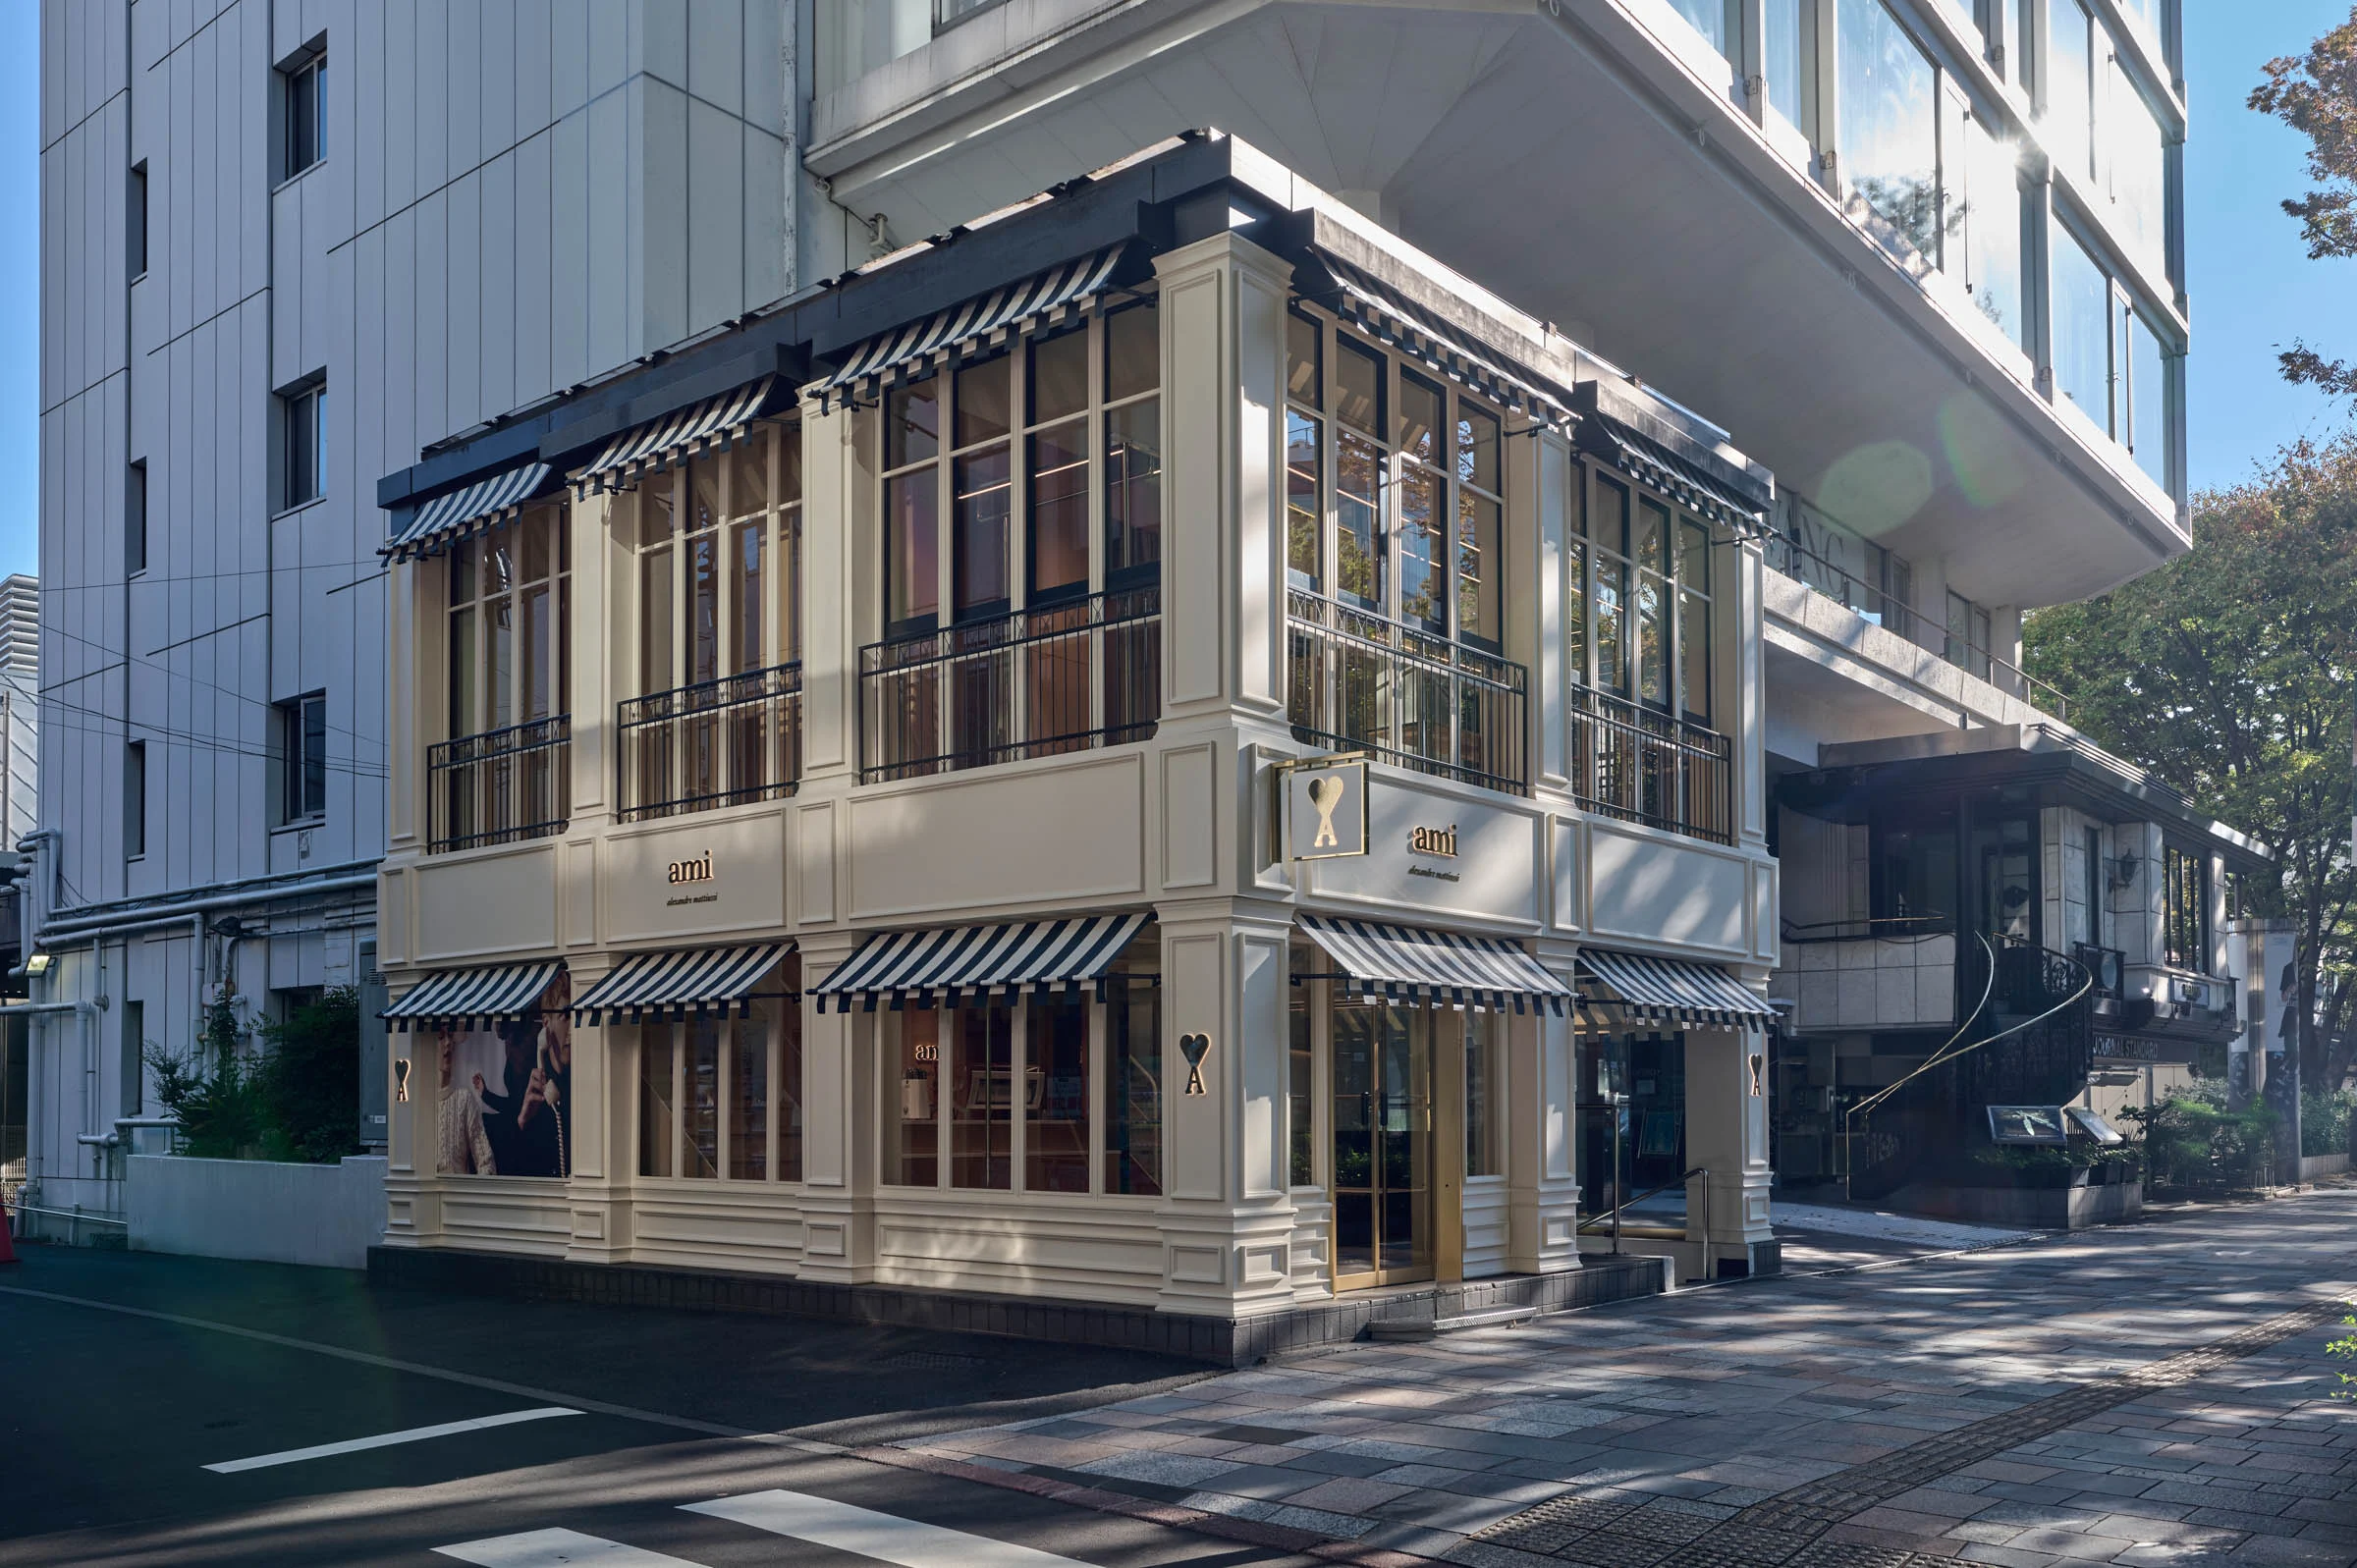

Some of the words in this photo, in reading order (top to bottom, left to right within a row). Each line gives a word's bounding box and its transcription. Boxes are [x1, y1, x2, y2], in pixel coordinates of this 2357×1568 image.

[1411, 824, 1458, 858] ami
[668, 848, 714, 885] ami
[2093, 1036, 2124, 1057] JOURNAL
[2124, 1039, 2159, 1060] STANDARD
